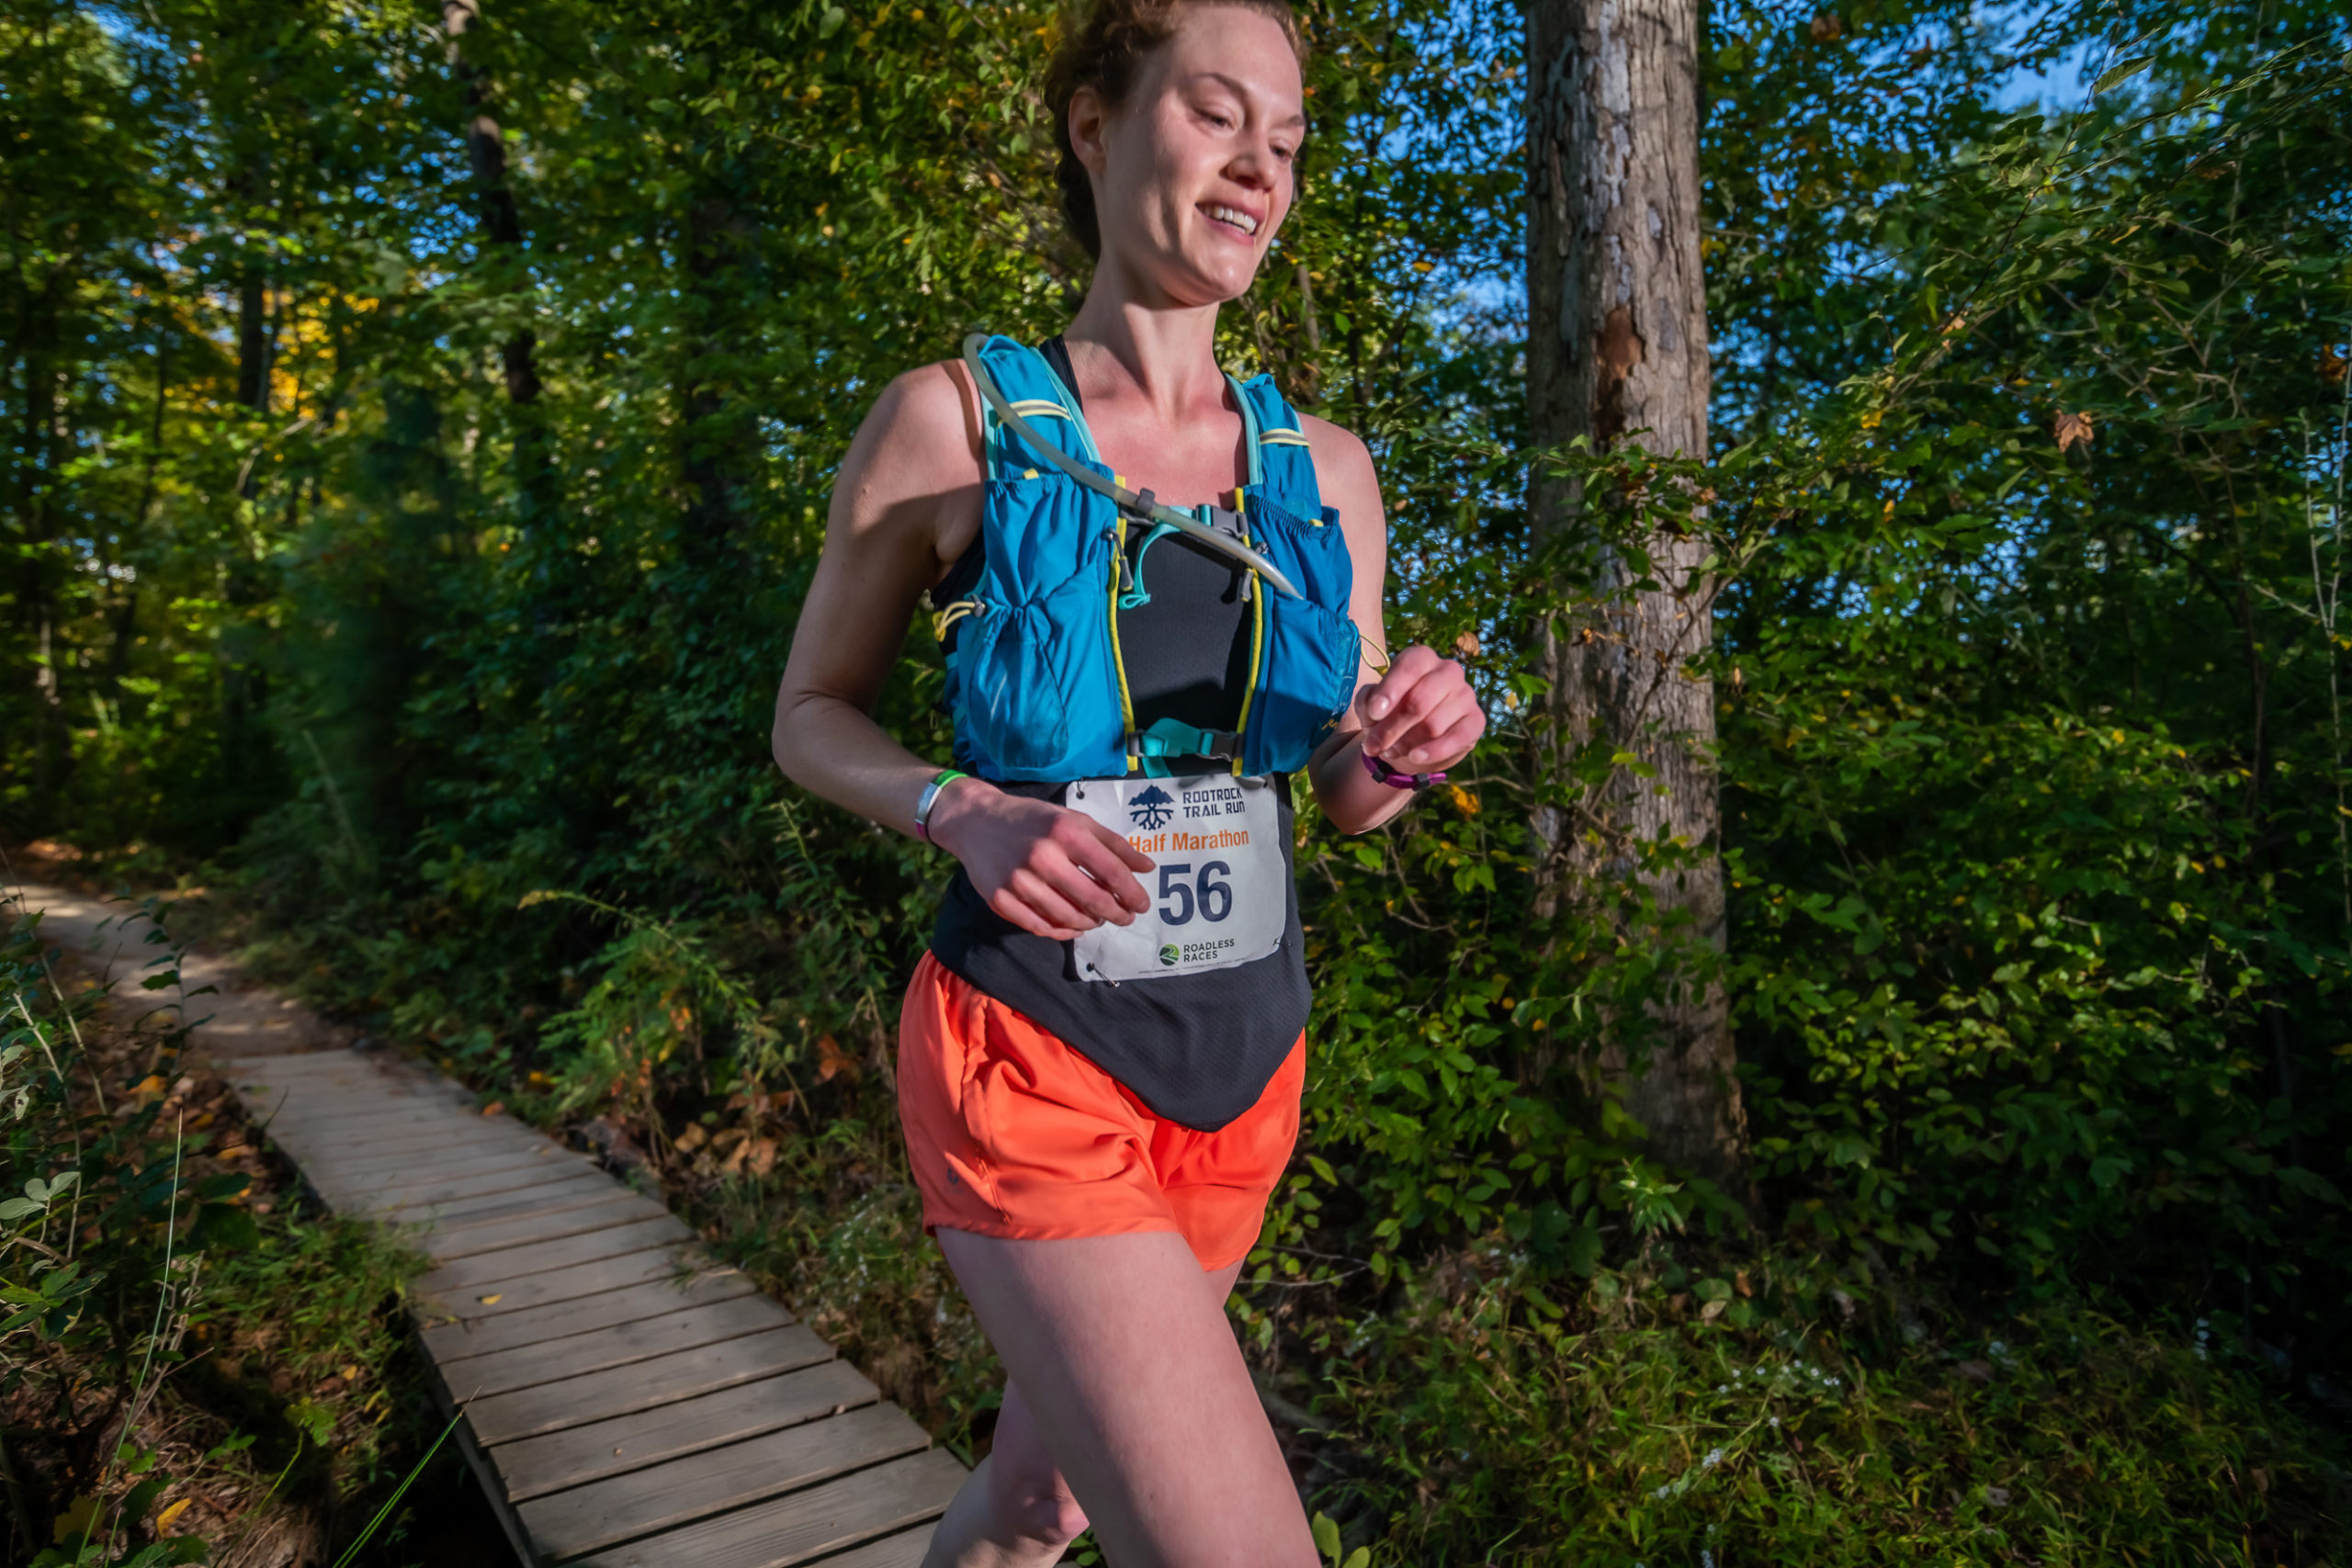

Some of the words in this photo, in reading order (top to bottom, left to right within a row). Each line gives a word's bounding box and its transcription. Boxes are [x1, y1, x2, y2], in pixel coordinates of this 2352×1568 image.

[1183, 787, 1242, 804] ROOTROCK
[1183, 804, 1221, 818] TRAIL
[1226, 801, 1245, 814] RUN
[1129, 833, 1166, 852] Half
[1172, 829, 1250, 851] Marathon
[1159, 861, 1232, 925] 56
[1183, 939, 1235, 953] ROADLESS
[1183, 951, 1217, 963] RACES
